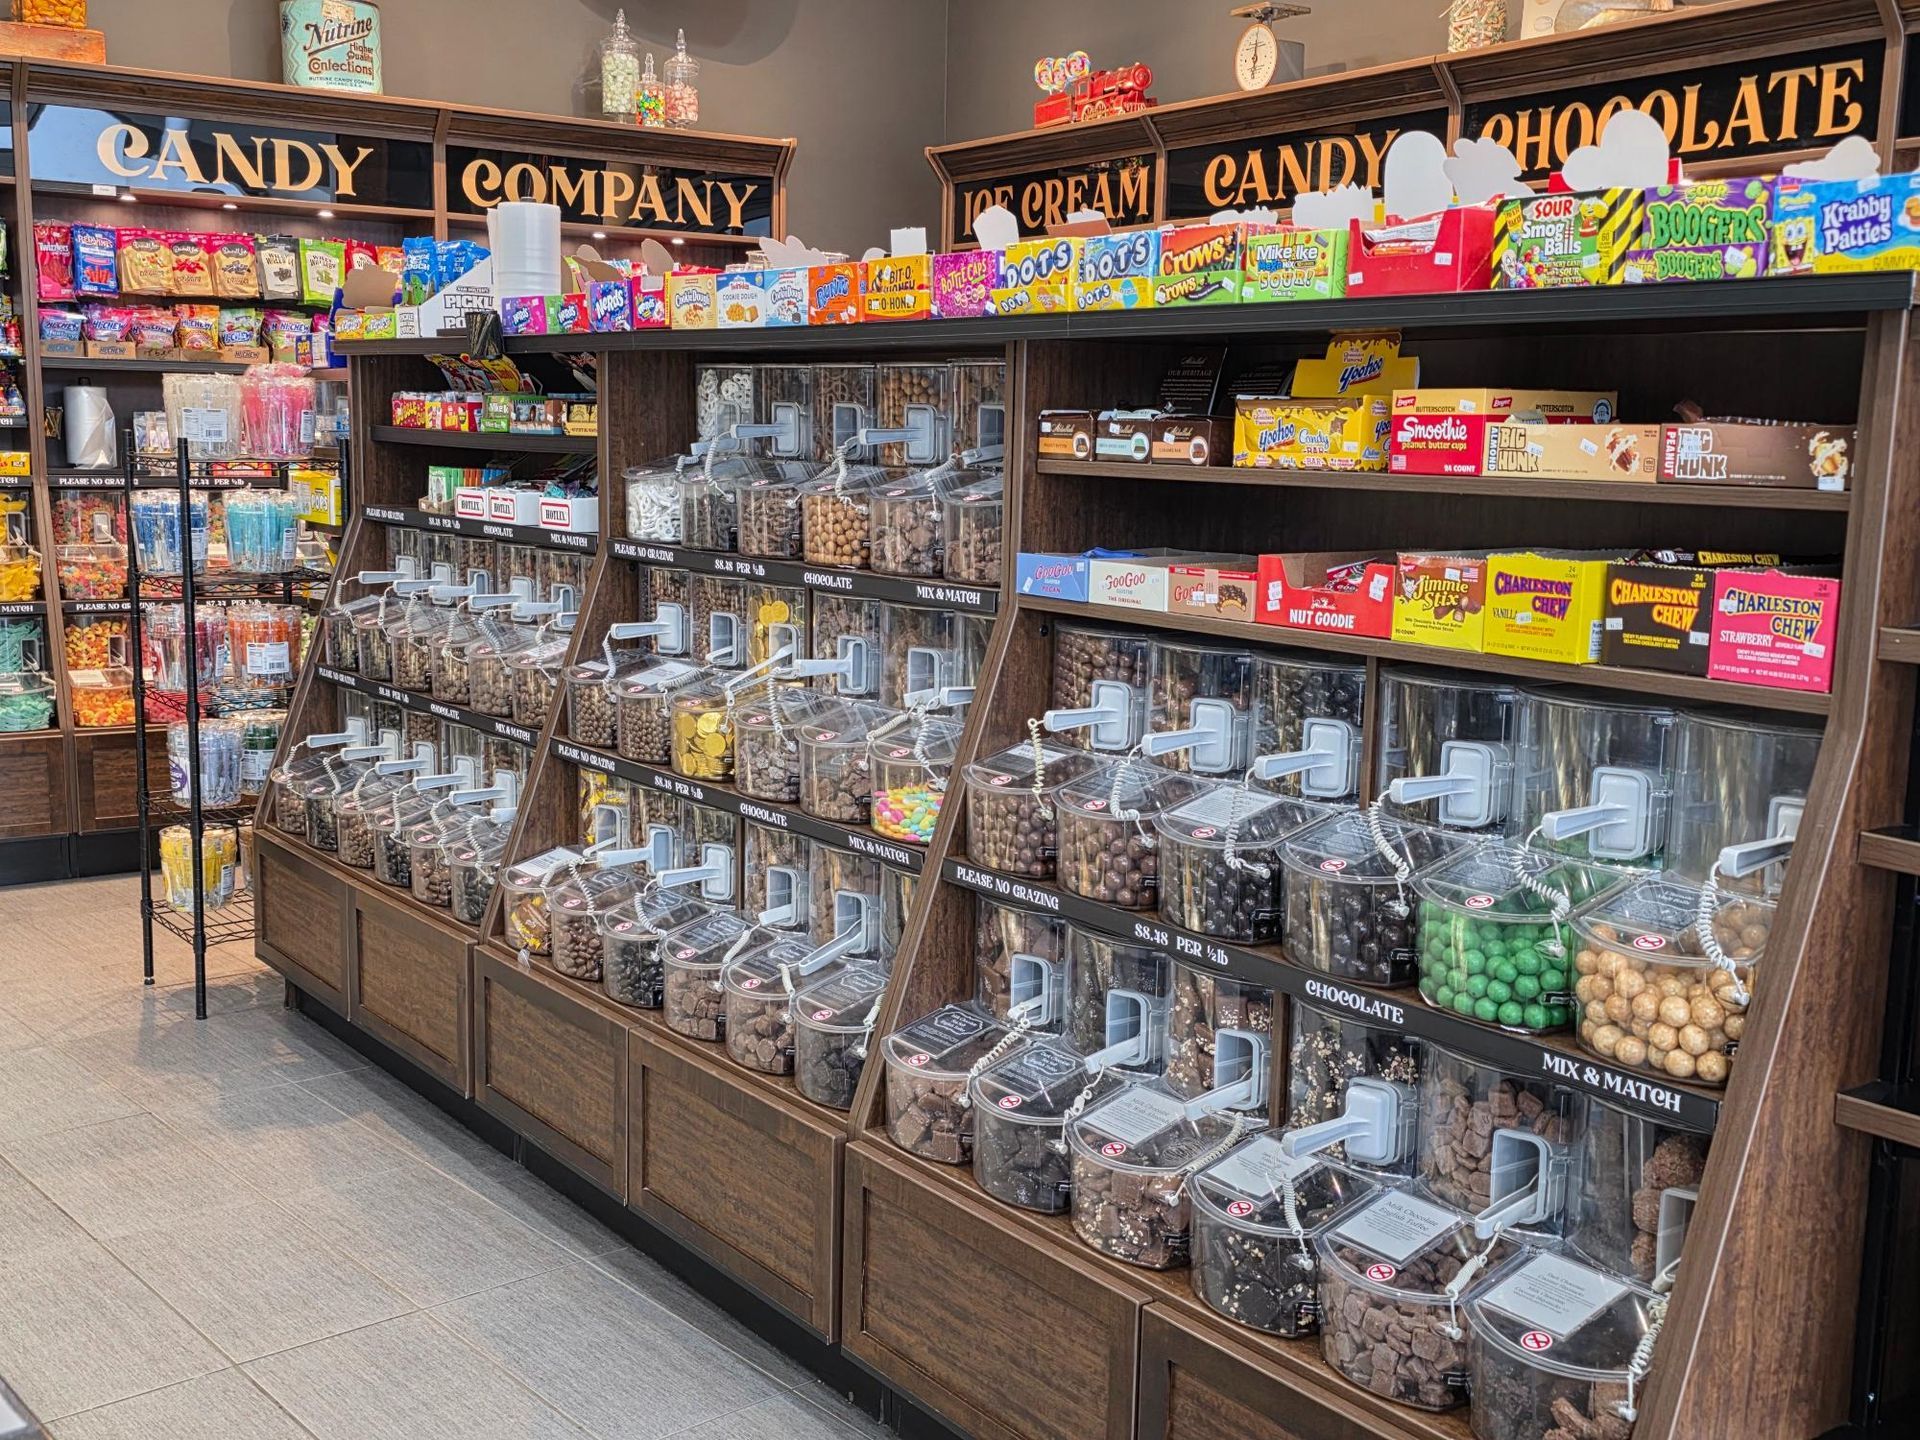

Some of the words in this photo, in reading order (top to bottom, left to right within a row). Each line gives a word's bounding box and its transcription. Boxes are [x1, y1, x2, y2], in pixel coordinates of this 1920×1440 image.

[304, 17, 372, 50] Nutrine
[97, 123, 375, 197] CANDY
[1204, 129, 1401, 207] CANDY
[462, 158, 759, 228] COMPANY
[1021, 166, 1150, 229] CREAM
[1535, 198, 1574, 219] SOUR
[1822, 194, 1893, 230] Krabby
[1521, 221, 1566, 242] Smog
[1650, 203, 1765, 247] BOOGERS
[1545, 228, 1583, 257] Balls
[1823, 221, 1893, 255] Patties
[1006, 240, 1074, 289] DOTS
[1086, 234, 1149, 284] DOTS
[1257, 244, 1292, 261] Mike
[1296, 244, 1318, 260] Ike
[1656, 252, 1724, 281] BOOGERS
[1299, 428, 1331, 449] Candy
[1403, 416, 1468, 441] Smoothie
[1499, 426, 1527, 449] BIG
[1428, 440, 1450, 450] butter
[1451, 442, 1467, 451] cups
[1488, 426, 1499, 471] ALMOND
[1664, 430, 1677, 475] PEANUT
[1453, 465, 1475, 473] COUNT
[1497, 449, 1539, 473] HUNK
[1675, 453, 1728, 480] HUNK
[311, 493, 328, 512] POPS
[461, 499, 480, 512] HOTLIX
[494, 500, 511, 514] HOTLIX
[545, 509, 566, 523] HOTLIX
[614, 544, 637, 556] PLEASE
[638, 547, 646, 558] NO
[647, 548, 674, 562] GRAZING
[1698, 551, 1753, 565] CHARLESTON
[1753, 552, 1780, 566] CHEW
[736, 562, 751, 574] PER
[1694, 574, 1704, 582] 24
[804, 572, 853, 590] CHOCOLATE
[1415, 575, 1468, 599] Jimmie
[1494, 570, 1573, 598] CHARLESTON
[1611, 578, 1700, 607] CHARLESTON
[76, 603, 106, 611] PLEASE
[916, 585, 935, 600] MIX
[935, 588, 945, 601] &
[945, 589, 981, 605] MATCH
[1423, 591, 1460, 612] Stix
[1290, 608, 1312, 625] NUT
[1314, 610, 1355, 630] GOODIE
[1532, 595, 1573, 621] CHEW
[1652, 604, 1699, 632] CHEW
[1720, 630, 1774, 648] STRAWBERRY
[1771, 616, 1821, 642] CHEW
[558, 744, 580, 761] PLEASE
[581, 751, 590, 763] NO
[590, 753, 616, 772] GRAZING
[675, 782, 690, 796] PER
[740, 802, 788, 827] CHOCOLATE
[848, 834, 866, 850] MIX
[866, 841, 875, 852] &
[875, 841, 910, 865] MATCH
[957, 866, 994, 890] PLEASE
[995, 878, 1011, 894] NO
[1013, 882, 1059, 911] GRAZING
[1176, 936, 1203, 958] PER
[1305, 979, 1404, 1025] CHOCOLATE
[1542, 1052, 1580, 1081] MIX
[1583, 1066, 1601, 1085] &
[1604, 1072, 1682, 1114] MATCH
[1380, 1207, 1406, 1221] English
[1404, 1208, 1439, 1227] Chocolate
